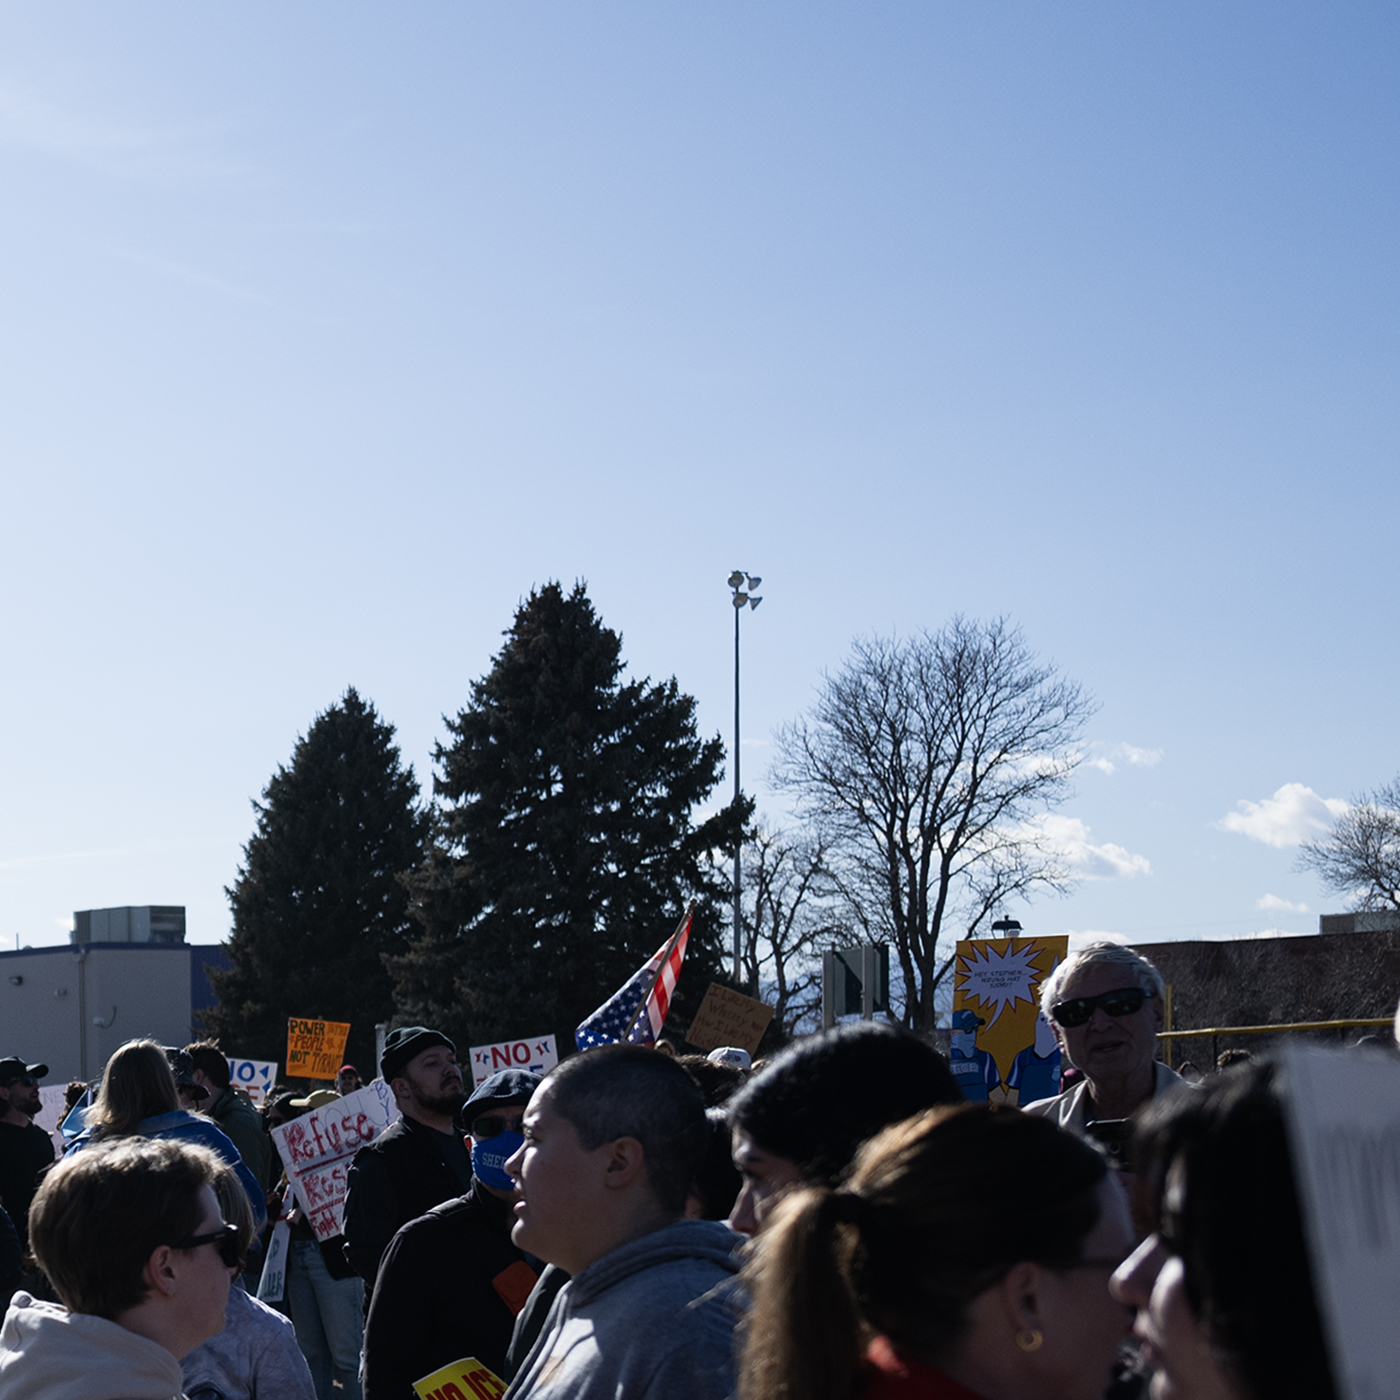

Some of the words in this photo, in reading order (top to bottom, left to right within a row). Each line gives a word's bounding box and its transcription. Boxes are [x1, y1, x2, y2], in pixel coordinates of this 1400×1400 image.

[290, 1020, 325, 1036] POWER
[296, 1035, 325, 1051] PEOPLE
[289, 1050, 310, 1064] NOT
[491, 1042, 531, 1068] NO
[282, 1112, 374, 1165] Refuse
